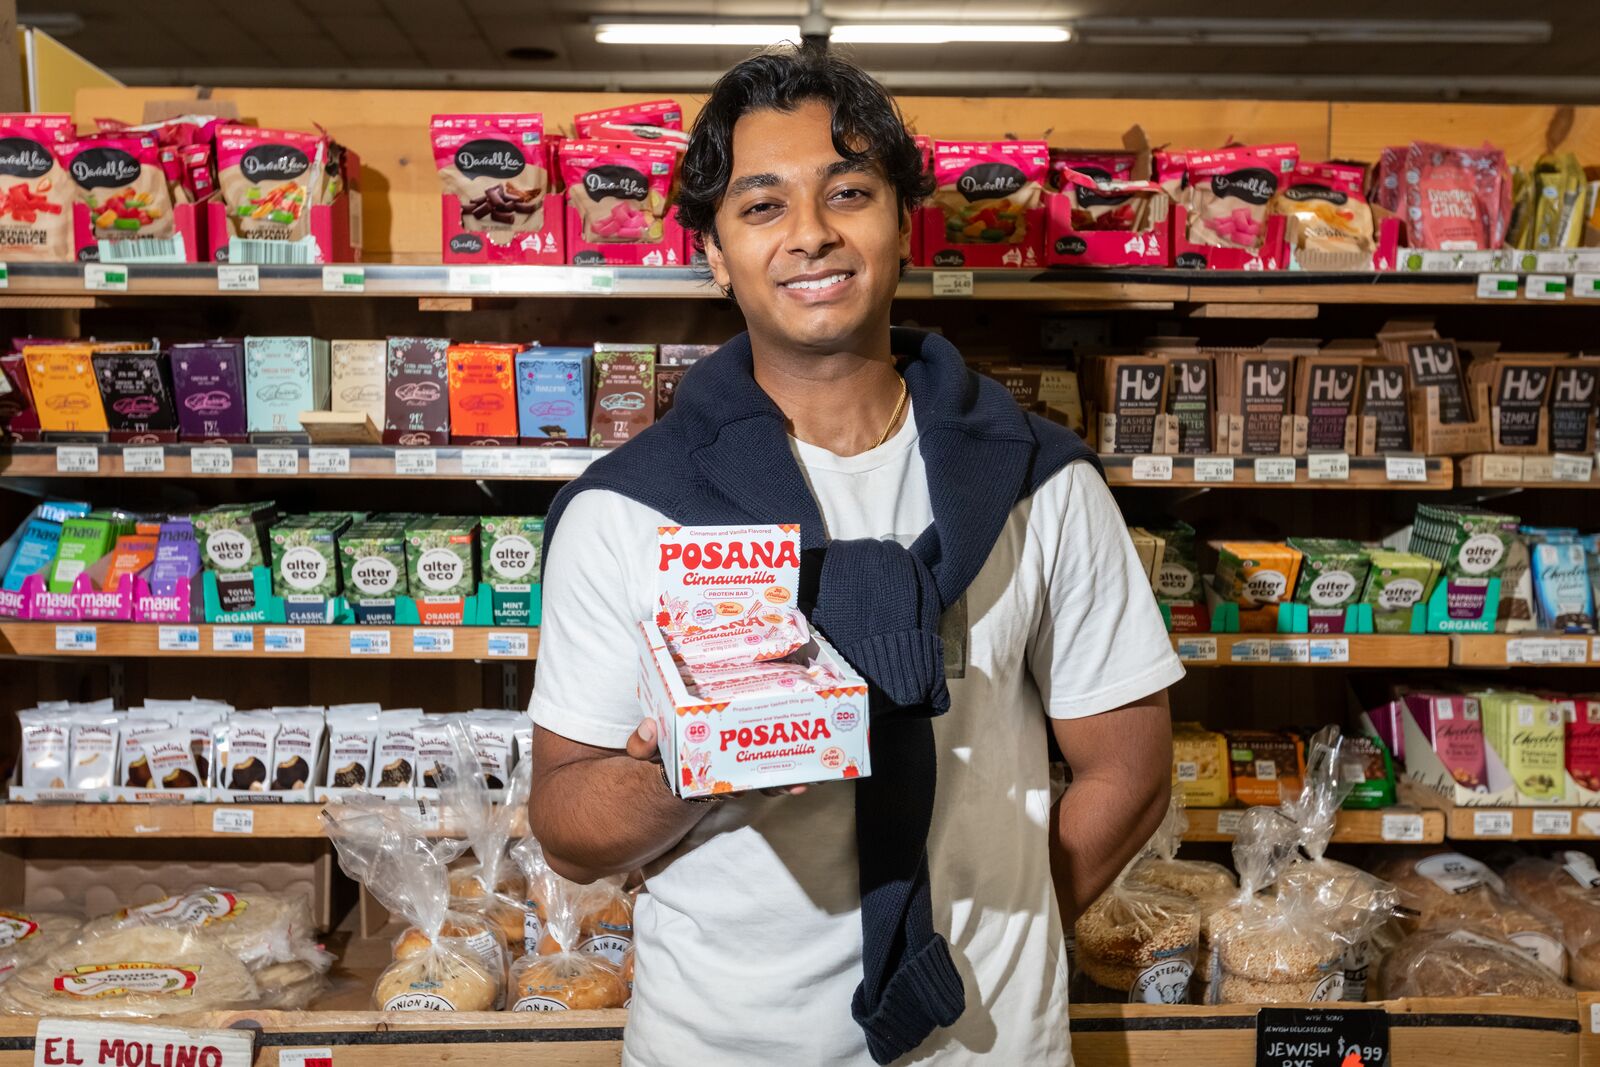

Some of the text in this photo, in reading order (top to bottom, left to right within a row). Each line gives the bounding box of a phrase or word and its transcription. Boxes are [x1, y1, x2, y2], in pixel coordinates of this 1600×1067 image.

[458, 152, 524, 170] Darrell Lea
[212, 541, 245, 552] alter
[219, 552, 243, 560] eco
[496, 549, 530, 559] alter
[659, 541, 800, 571] POSANA
[1465, 547, 1498, 557] alter
[287, 560, 321, 570] alter
[500, 560, 526, 568] eco
[1467, 556, 1492, 565] eco
[423, 561, 457, 571] alter
[292, 571, 317, 580] eco
[357, 568, 391, 578] alter
[428, 572, 454, 580] eco
[363, 578, 388, 586] eco
[683, 571, 776, 586] Cinnavanilla
[1248, 580, 1282, 589] alter
[1316, 582, 1350, 591] alter
[1250, 588, 1276, 597] eco
[1318, 590, 1344, 598] eco
[1384, 587, 1419, 597] alter
[36, 593, 80, 610] magic
[81, 593, 122, 609] magic
[139, 596, 181, 612] magic
[1387, 595, 1412, 603] eco
[290, 612, 323, 620] CLASSIC
[425, 612, 460, 620] ORANGE
[1439, 621, 1489, 631] ORGANIC
[682, 628, 753, 645] Cinnavanilla
[235, 728, 266, 739] Justin's
[281, 727, 310, 739] Justin's
[474, 731, 505, 744] Justin's
[720, 718, 831, 752] POSANA
[338, 734, 368, 745] Justin's
[736, 743, 816, 763] Cinnavanilla
[391, 999, 420, 1011] ONION
[44, 1037, 223, 1067] EL MOLINO
[1267, 1042, 1330, 1057] JEWISH
